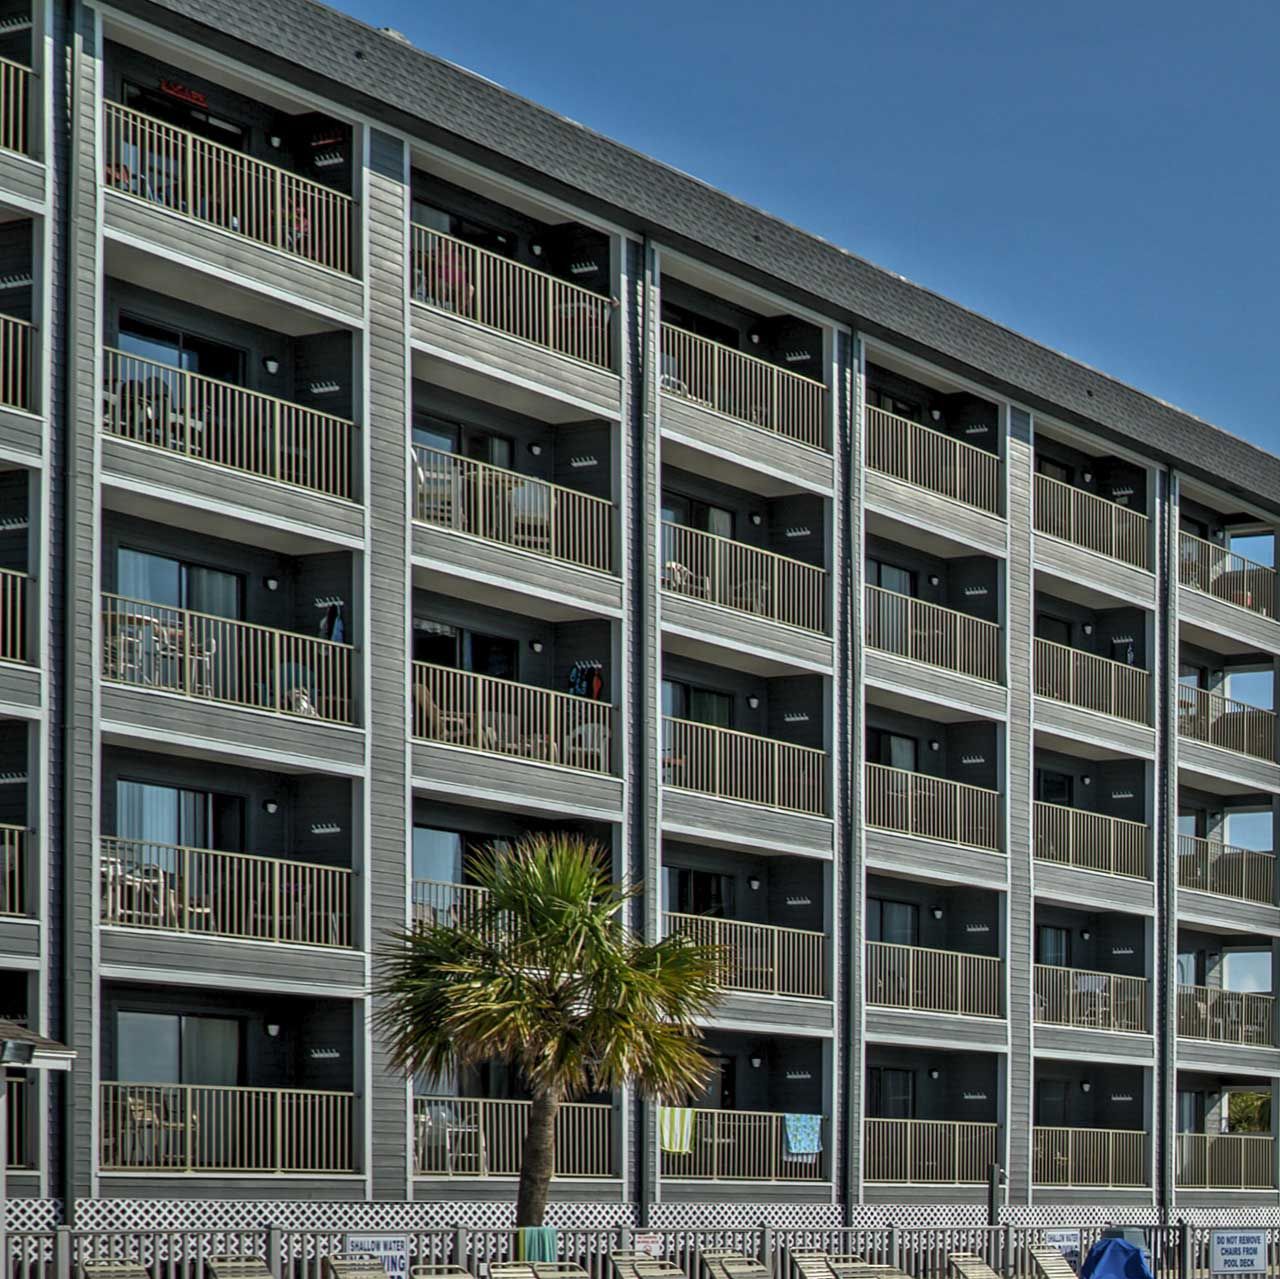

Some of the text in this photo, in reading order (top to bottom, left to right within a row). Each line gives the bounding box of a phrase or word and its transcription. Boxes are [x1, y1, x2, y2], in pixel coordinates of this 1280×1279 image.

[1217, 1235, 1261, 1245] DO NOT REMOVE
[351, 1240, 404, 1252] SHALLOW WATER
[1221, 1247, 1258, 1256] CHAIRS FROM
[1223, 1258, 1255, 1268] POOL DECK
